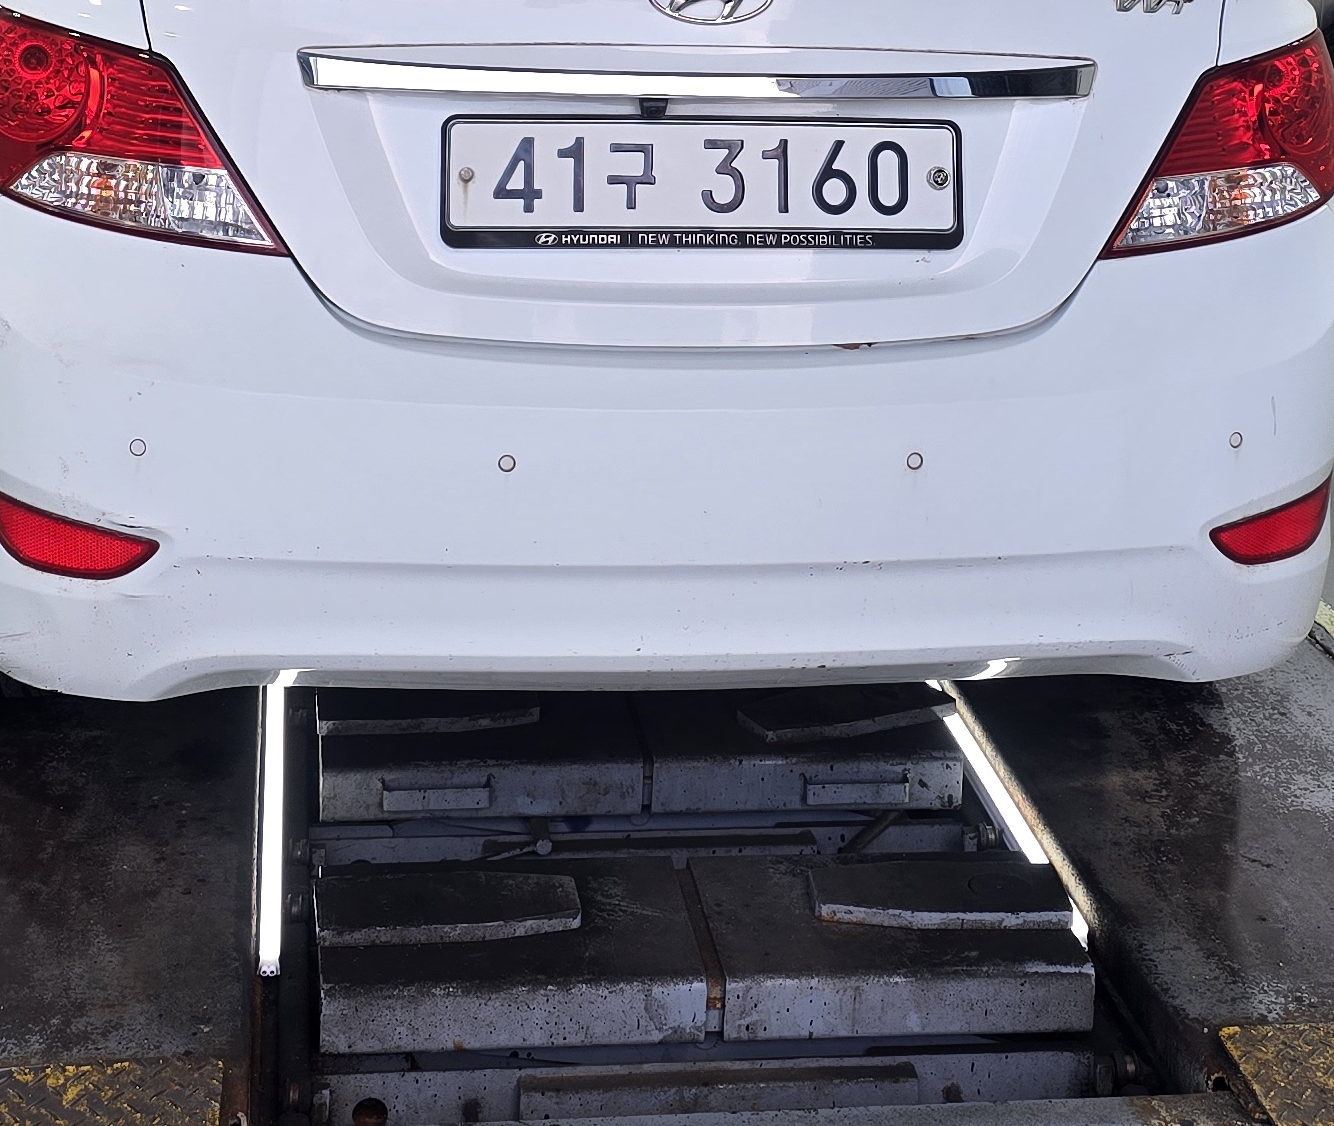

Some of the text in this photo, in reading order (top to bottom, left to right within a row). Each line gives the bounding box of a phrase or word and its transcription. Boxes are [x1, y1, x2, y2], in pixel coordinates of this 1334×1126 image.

[492, 136, 910, 217] 41구 3160
[561, 233, 621, 245] HYUNDAI
